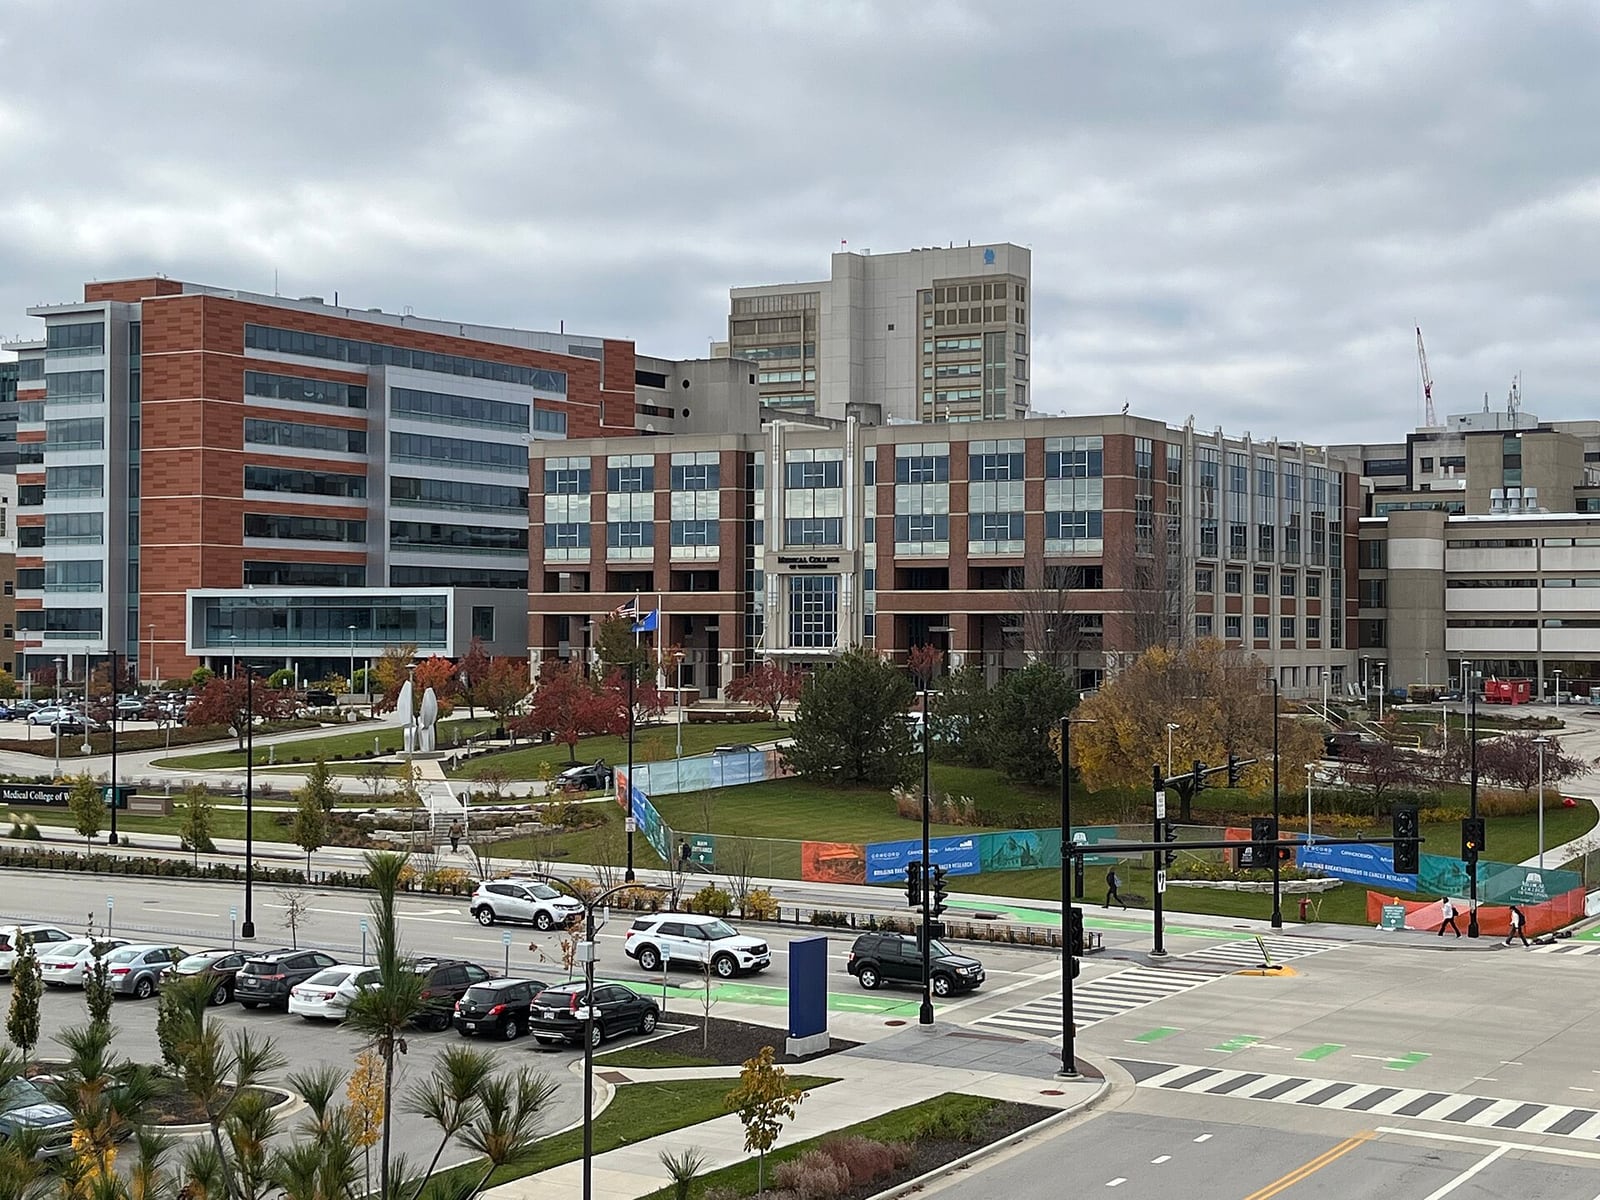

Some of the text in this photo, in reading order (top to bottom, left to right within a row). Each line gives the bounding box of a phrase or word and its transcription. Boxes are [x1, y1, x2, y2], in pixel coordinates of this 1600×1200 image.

[3, 790, 28, 799] Medical
[29, 791, 54, 802] College
[55, 792, 62, 800] of
[1325, 864, 1362, 876] BREAKTHROUGHS
[1369, 871, 1386, 880] CANCER
[1387, 874, 1409, 883] RESEARCH
